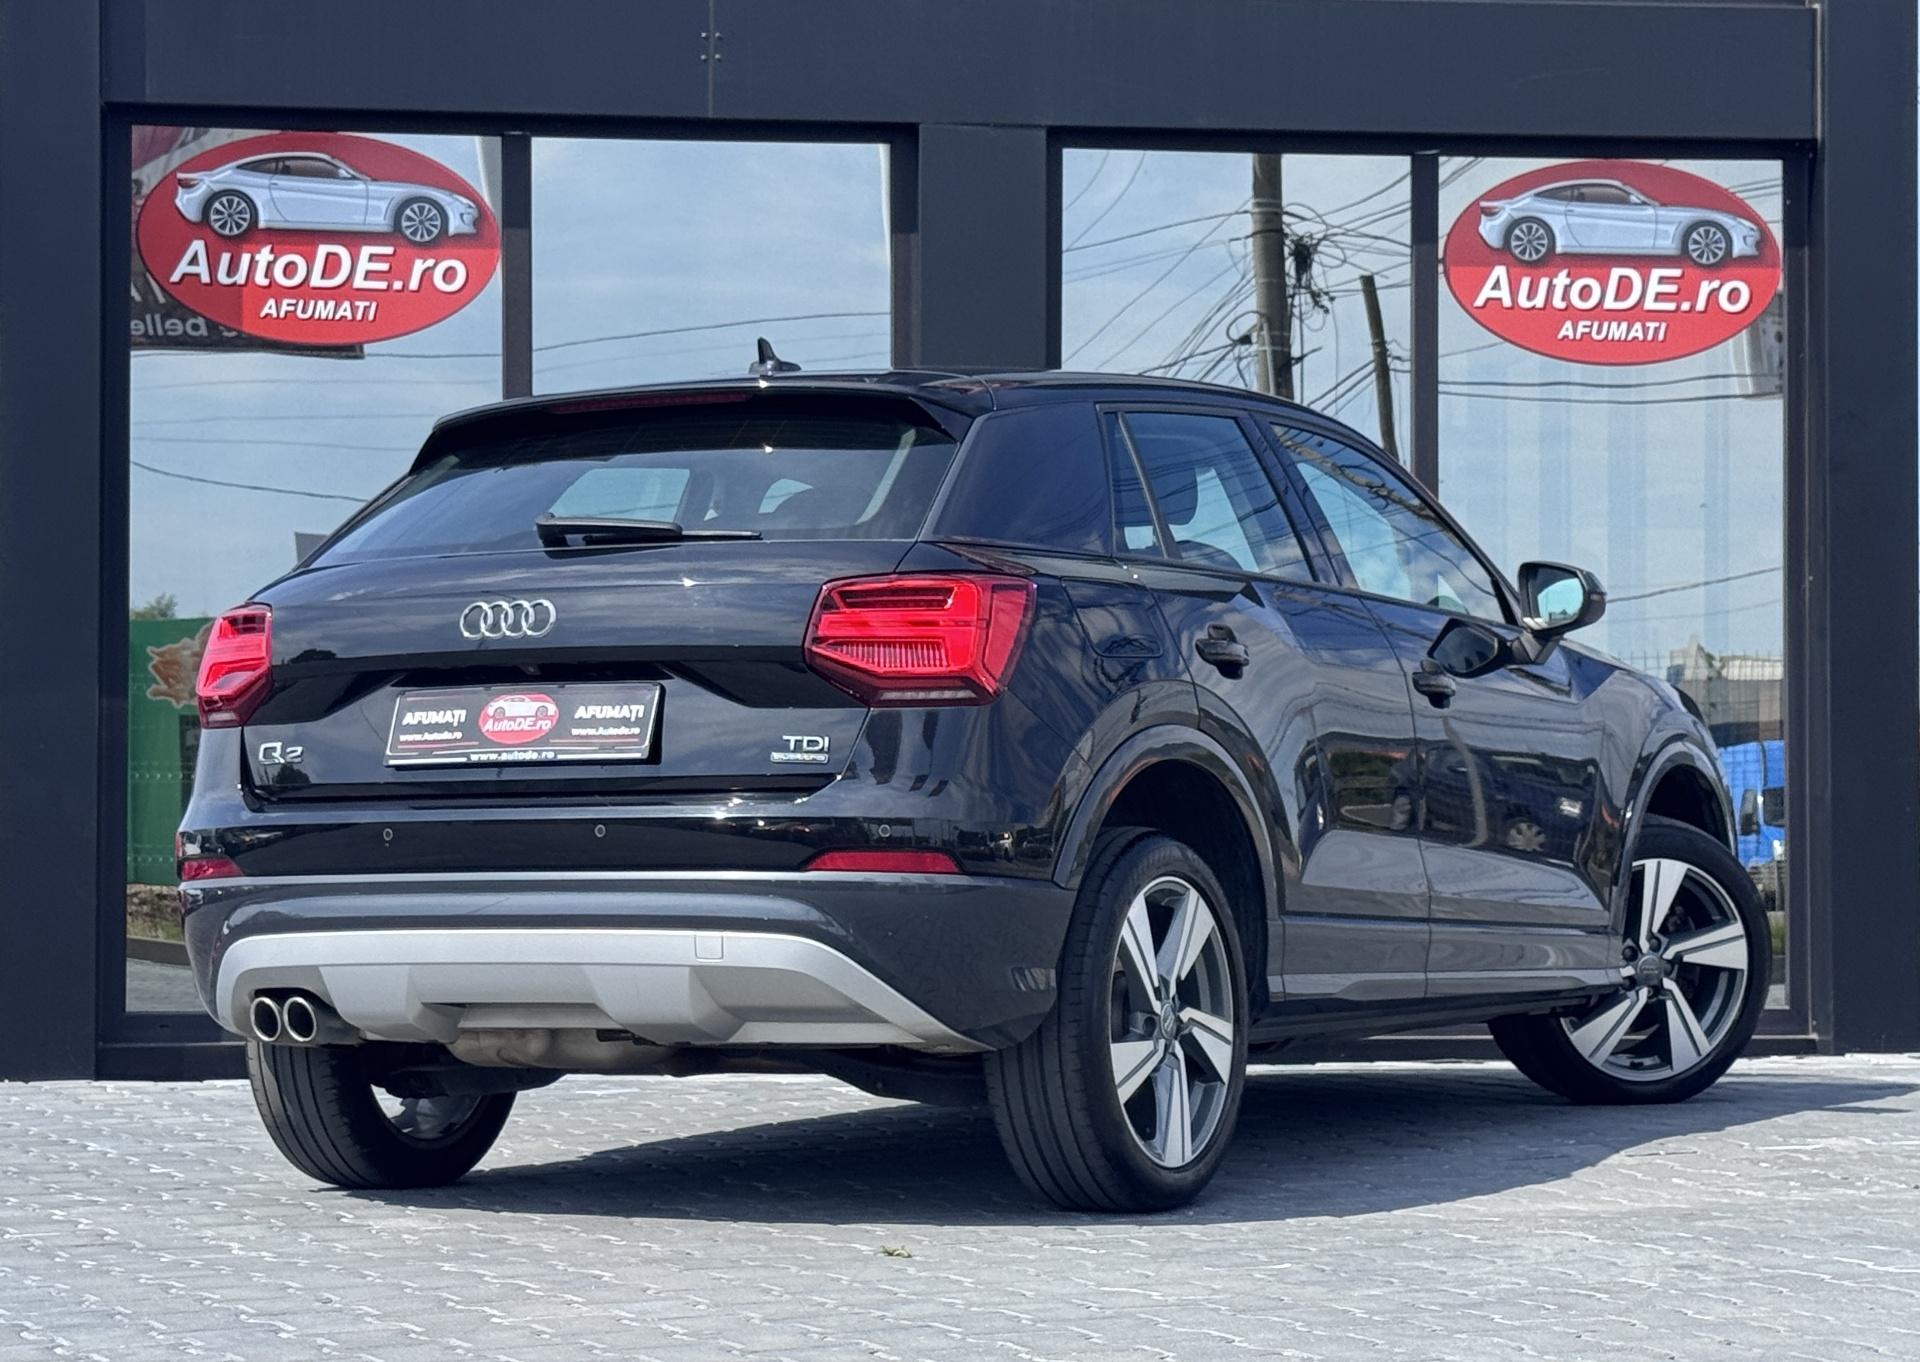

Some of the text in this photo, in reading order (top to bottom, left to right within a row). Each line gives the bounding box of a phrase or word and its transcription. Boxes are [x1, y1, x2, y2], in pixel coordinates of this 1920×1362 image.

[169, 240, 467, 293] AutoDE.ro
[1473, 265, 1750, 313] AutoDE.ro
[259, 298, 377, 322] AFUMATI
[1557, 320, 1667, 342] AFUMATI
[483, 717, 552, 732] AutoDE.ro
[258, 741, 303, 765] Q2
[782, 735, 830, 752] TDI
[470, 751, 555, 761] www.autode.ro
